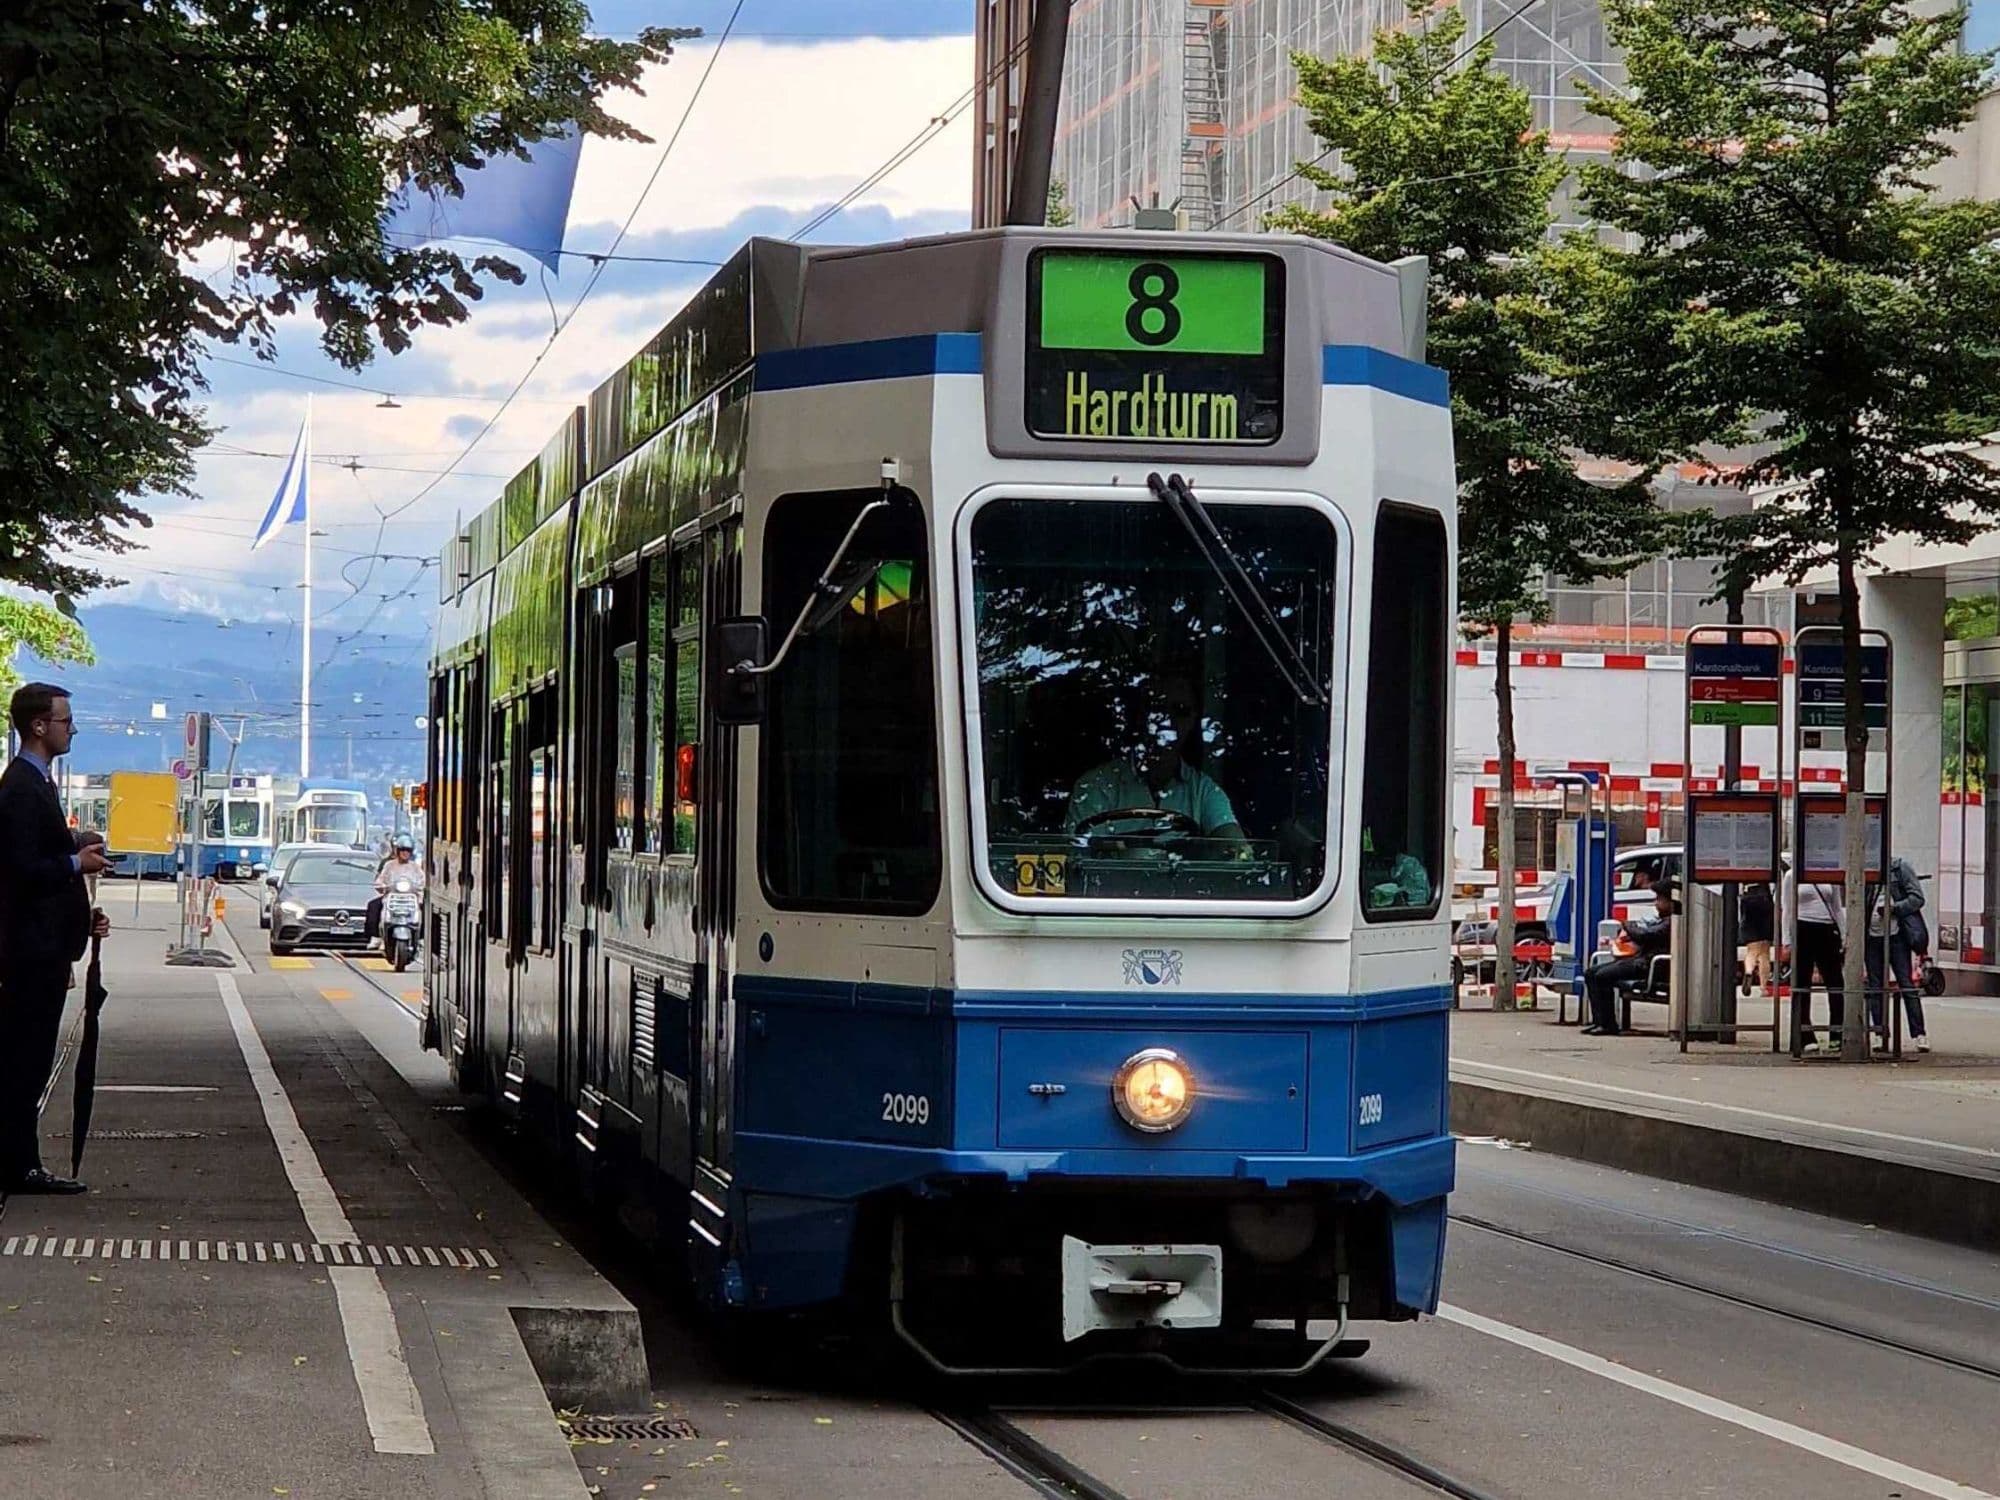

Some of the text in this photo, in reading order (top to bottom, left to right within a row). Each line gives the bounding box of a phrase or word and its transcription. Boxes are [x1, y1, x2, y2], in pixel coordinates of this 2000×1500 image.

[1125, 262, 1181, 347] 8
[1066, 371, 1237, 438] Hardturm
[1694, 662, 1761, 673] Kantonalbank
[1704, 687, 1713, 699] 2
[1813, 688, 1822, 701] 9
[1704, 711, 1712, 723] 8
[1809, 712, 1822, 725] 11
[882, 1092, 929, 1125] 2099
[1359, 1093, 1382, 1125] 2099
